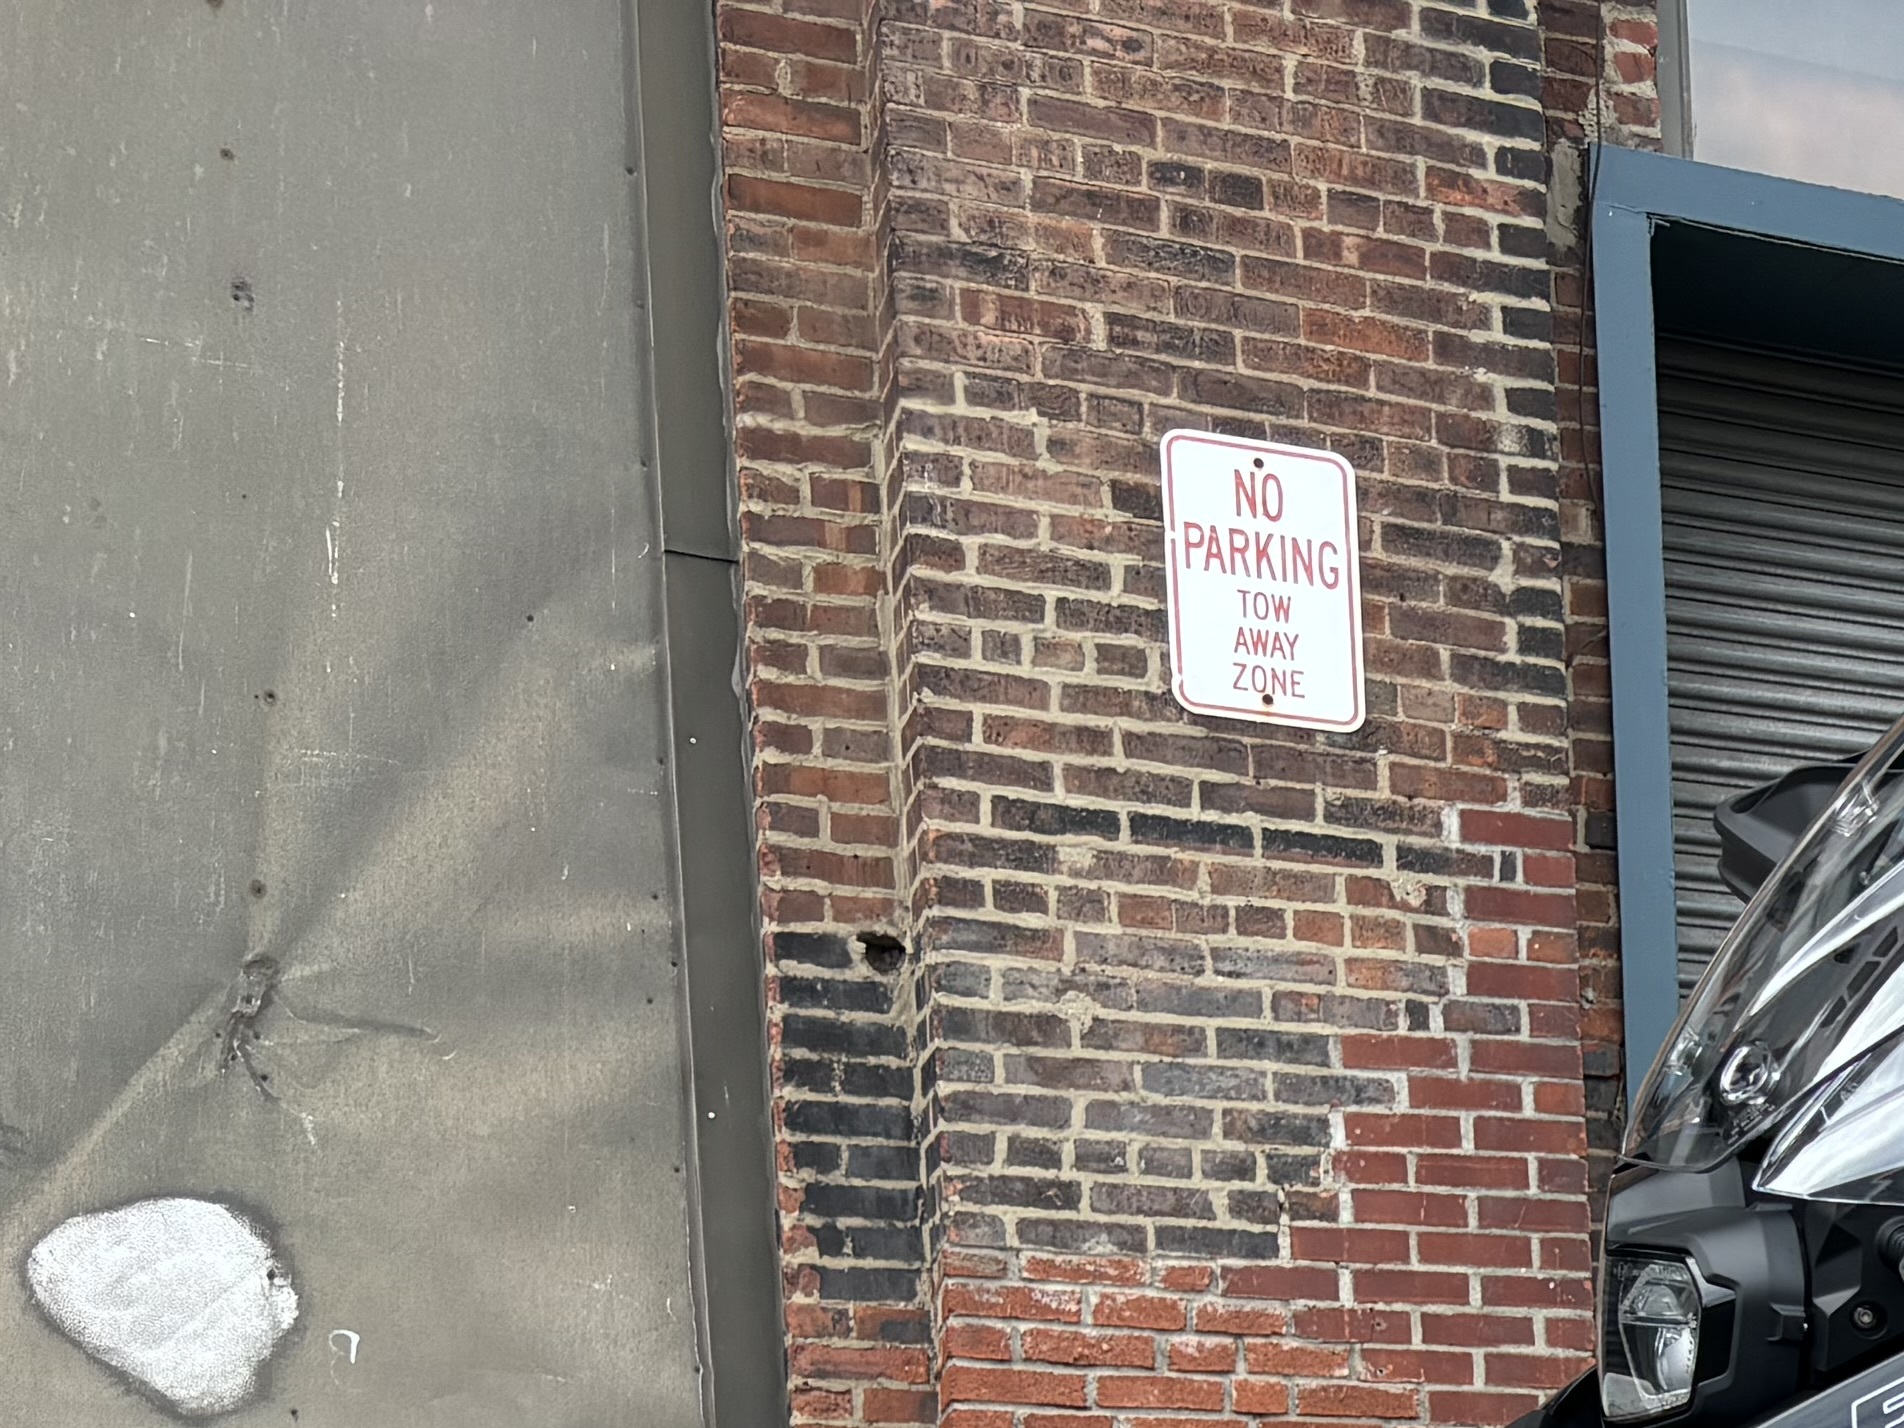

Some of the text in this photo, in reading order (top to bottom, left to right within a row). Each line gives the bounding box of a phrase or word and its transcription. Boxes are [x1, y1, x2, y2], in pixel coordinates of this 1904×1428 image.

[1233, 469, 1284, 523] NO
[1183, 521, 1340, 590] PARKING
[1236, 588, 1292, 624] TOW
[1233, 626, 1300, 662] AWAY
[1232, 662, 1306, 699] ZONE
